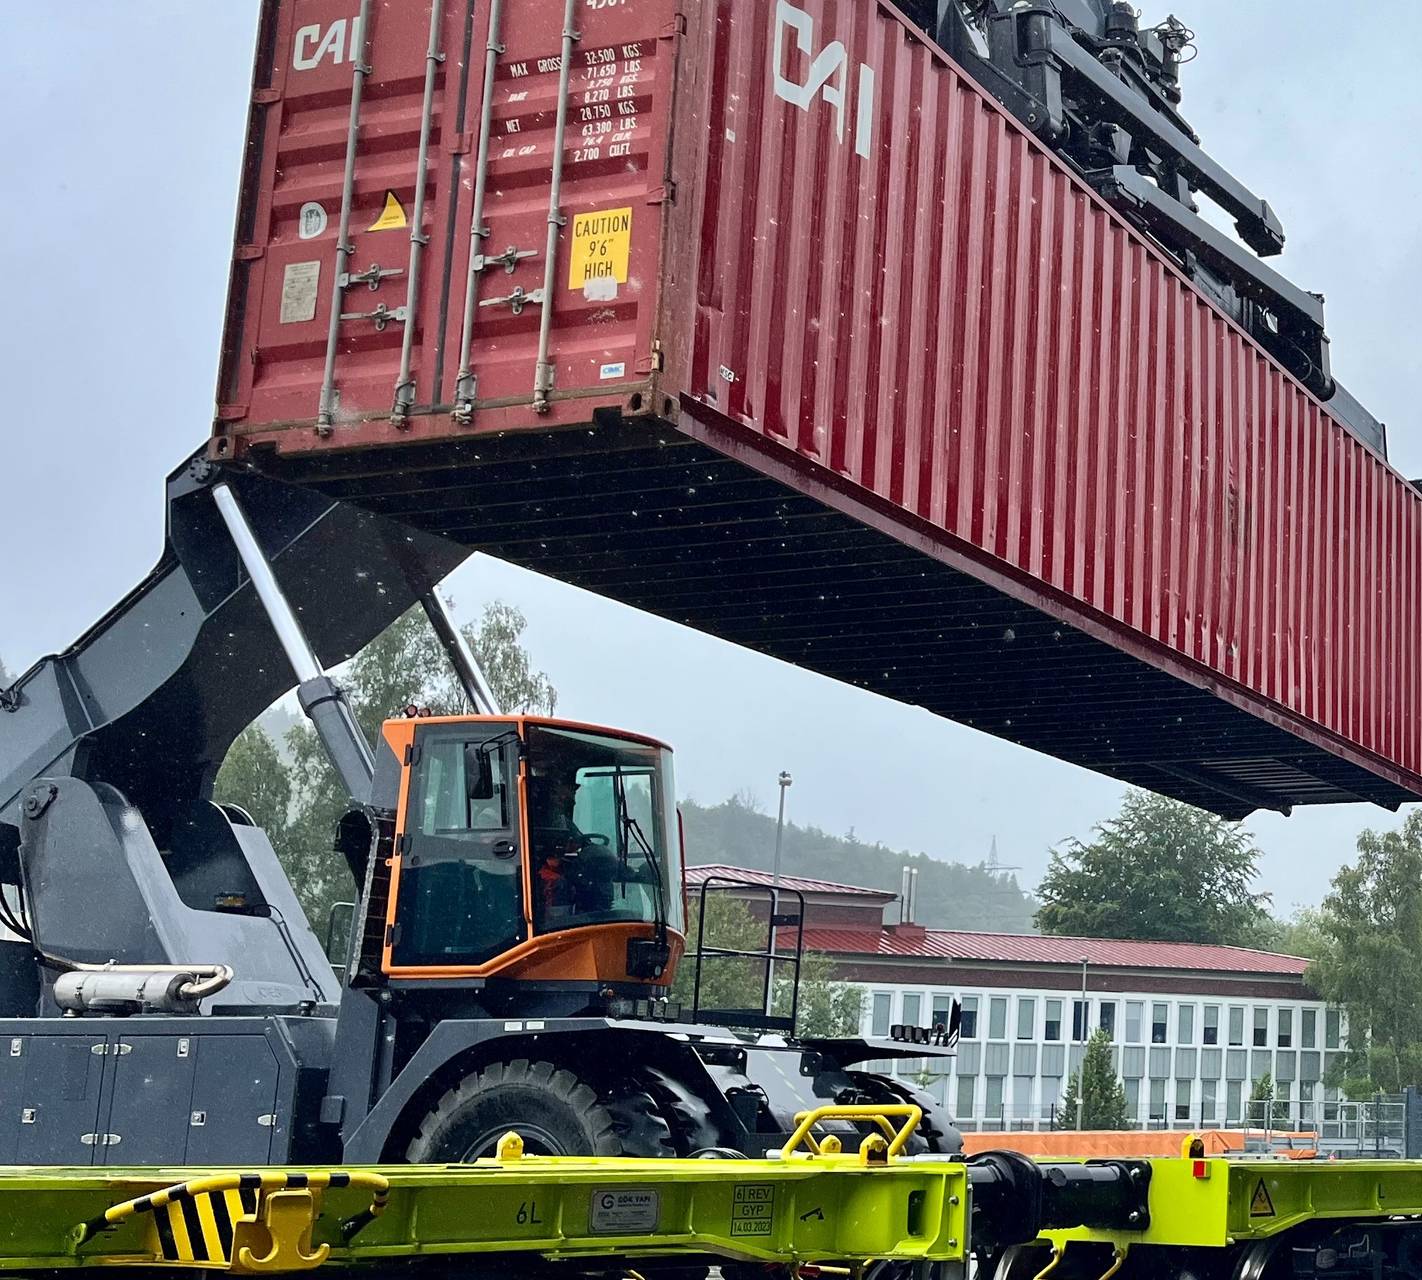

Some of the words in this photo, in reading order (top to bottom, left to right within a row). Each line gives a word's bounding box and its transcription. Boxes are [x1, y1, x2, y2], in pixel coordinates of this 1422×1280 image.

[510, 63, 528, 78] MAX
[585, 48, 616, 65] 32.500
[587, 64, 616, 79] 71.650
[774, 0, 875, 160] CAI
[506, 119, 520, 133] NET
[581, 105, 611, 121] 28.750
[575, 214, 629, 238] CAUTION
[584, 261, 613, 280] HIGH
[736, 1189, 743, 1199] 6
[749, 1188, 770, 1199] REV
[517, 1202, 542, 1224] 6L
[742, 1202, 764, 1216] GYP
